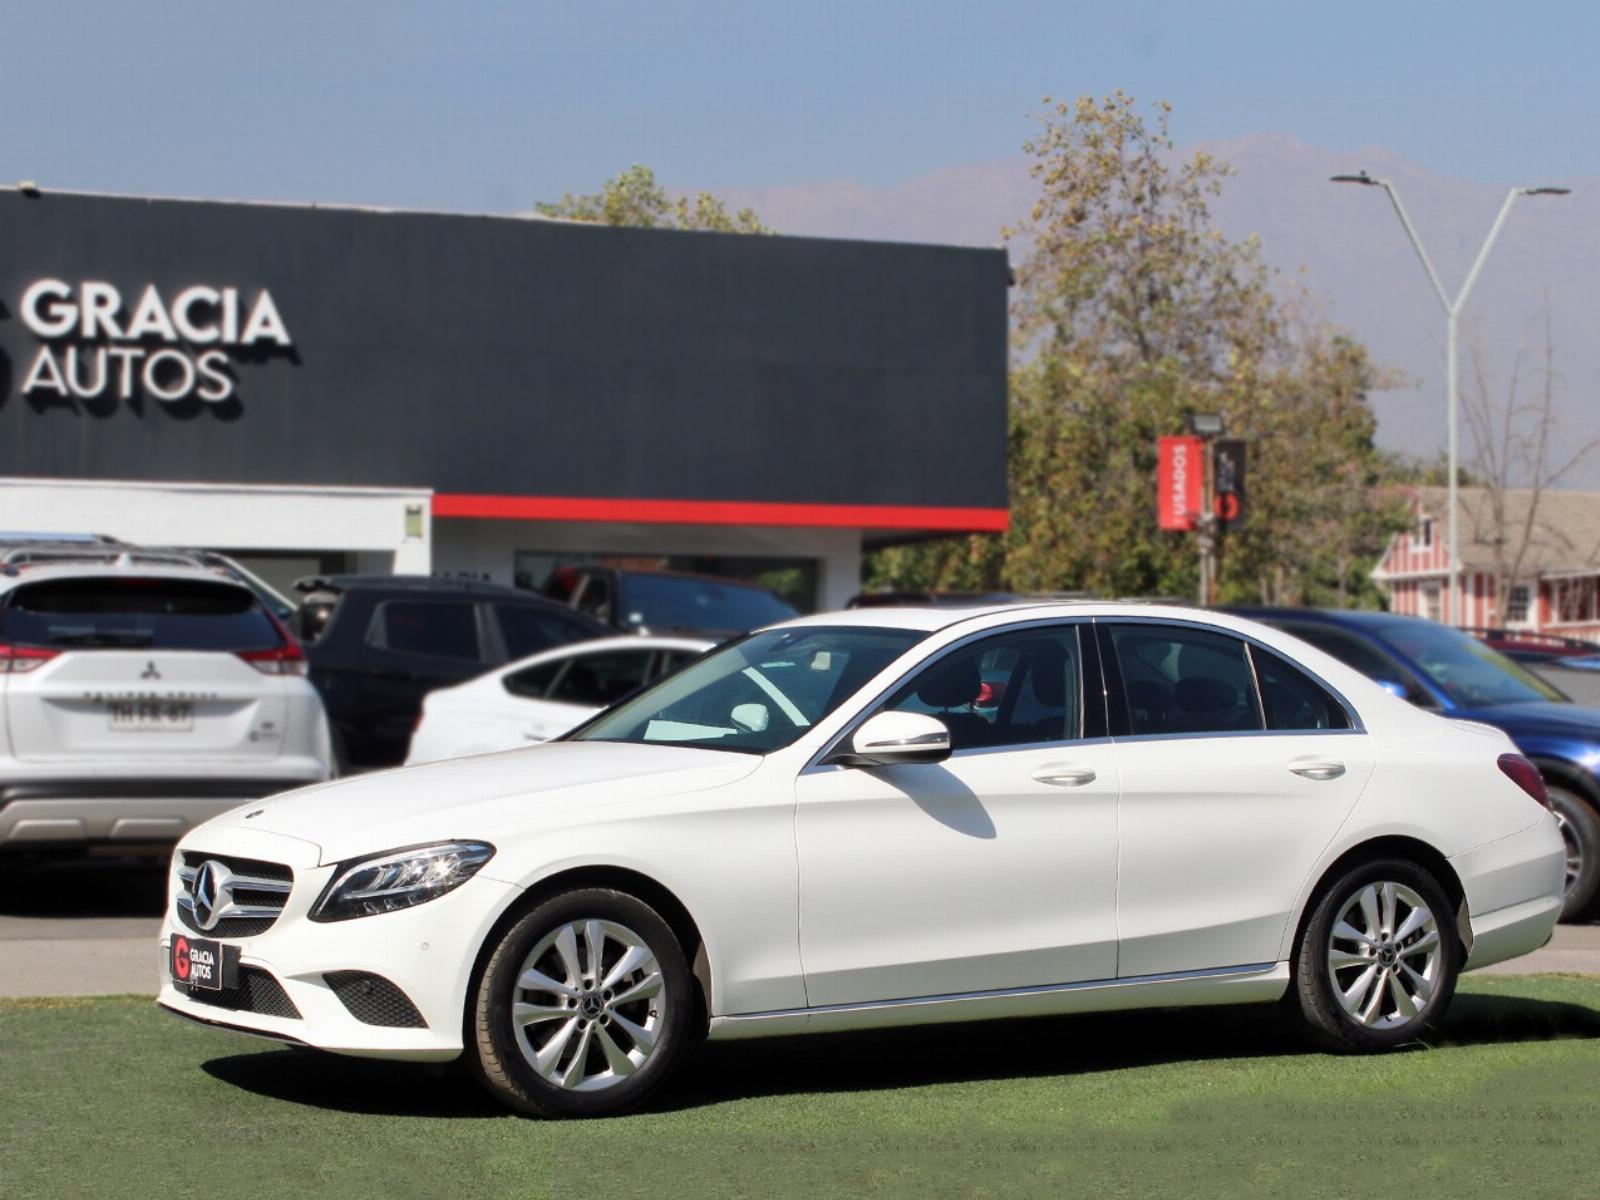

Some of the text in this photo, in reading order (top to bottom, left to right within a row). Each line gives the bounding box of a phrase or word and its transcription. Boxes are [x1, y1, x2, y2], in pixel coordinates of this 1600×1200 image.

[20, 278, 292, 345] GRACIA
[22, 345, 234, 401] AUTOS
[1172, 444, 1187, 516] USADOS
[190, 948, 215, 966] GRACIA
[190, 963, 212, 979] AUTOS
